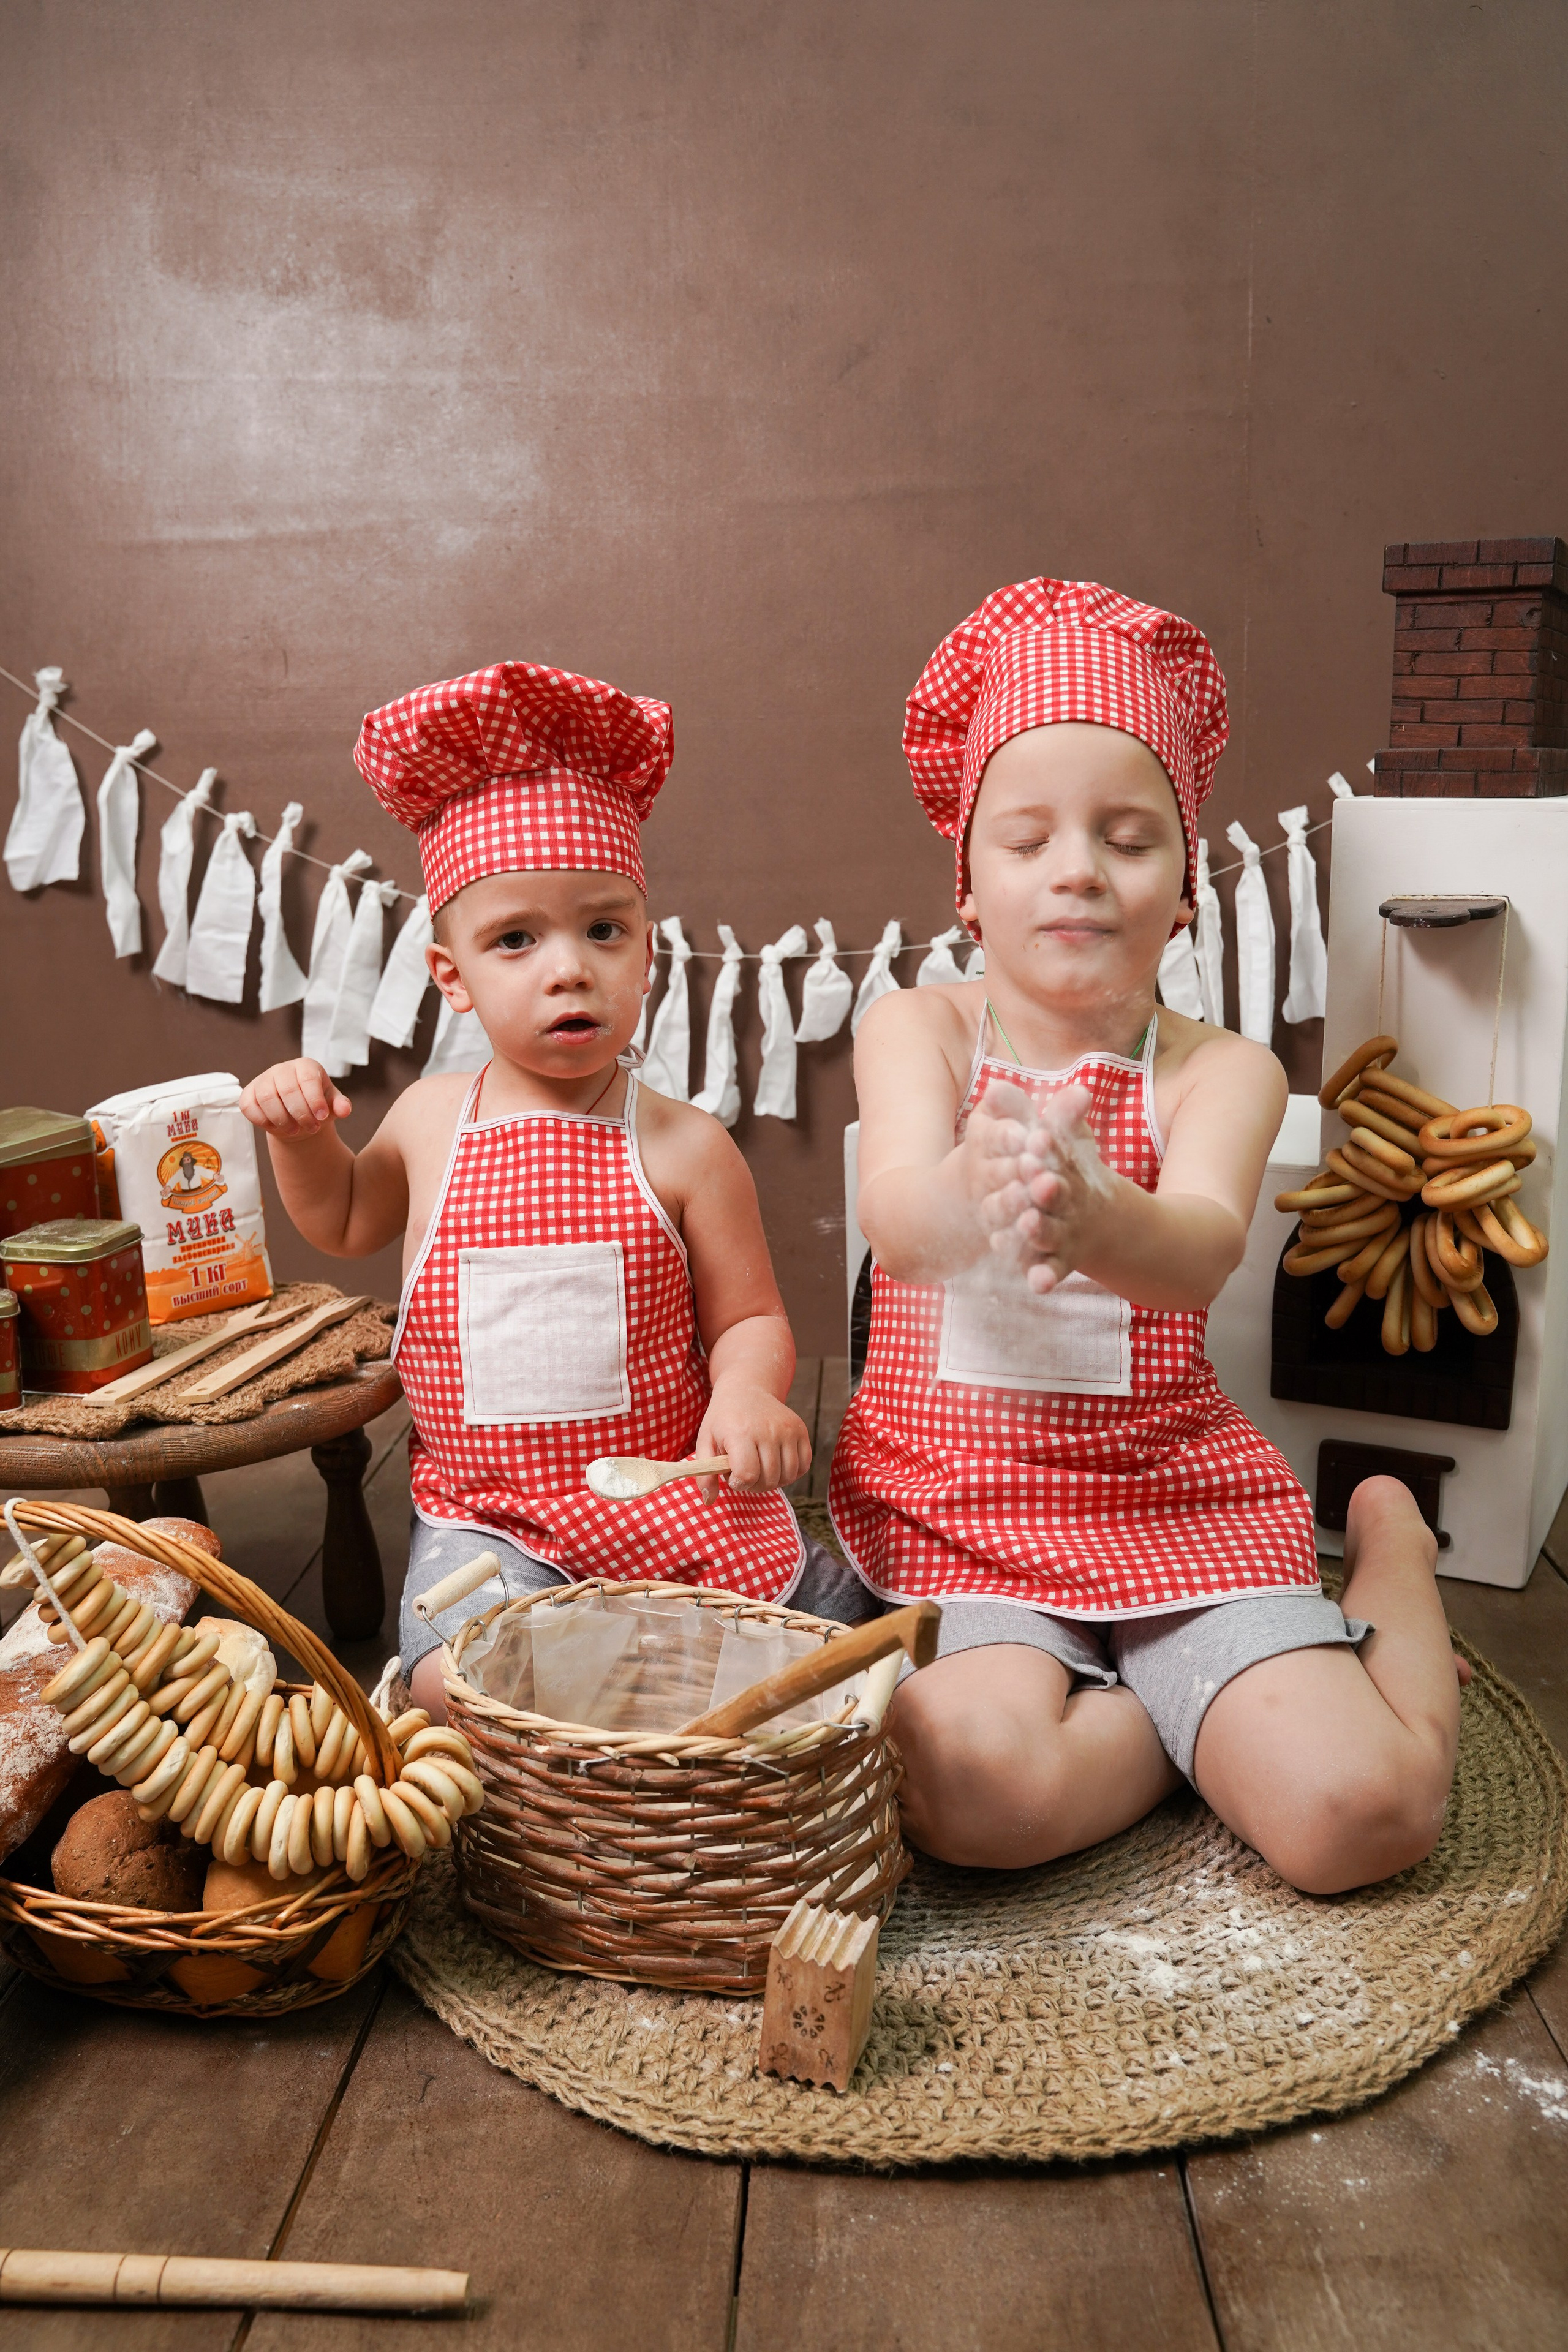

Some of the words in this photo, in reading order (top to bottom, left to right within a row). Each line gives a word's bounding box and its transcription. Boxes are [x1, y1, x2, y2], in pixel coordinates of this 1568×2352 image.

[172, 1110, 178, 1123] 1
[167, 1118, 199, 1137] МУКА
[166, 1208, 236, 1246] МУКА
[189, 1266, 201, 1287] 1
